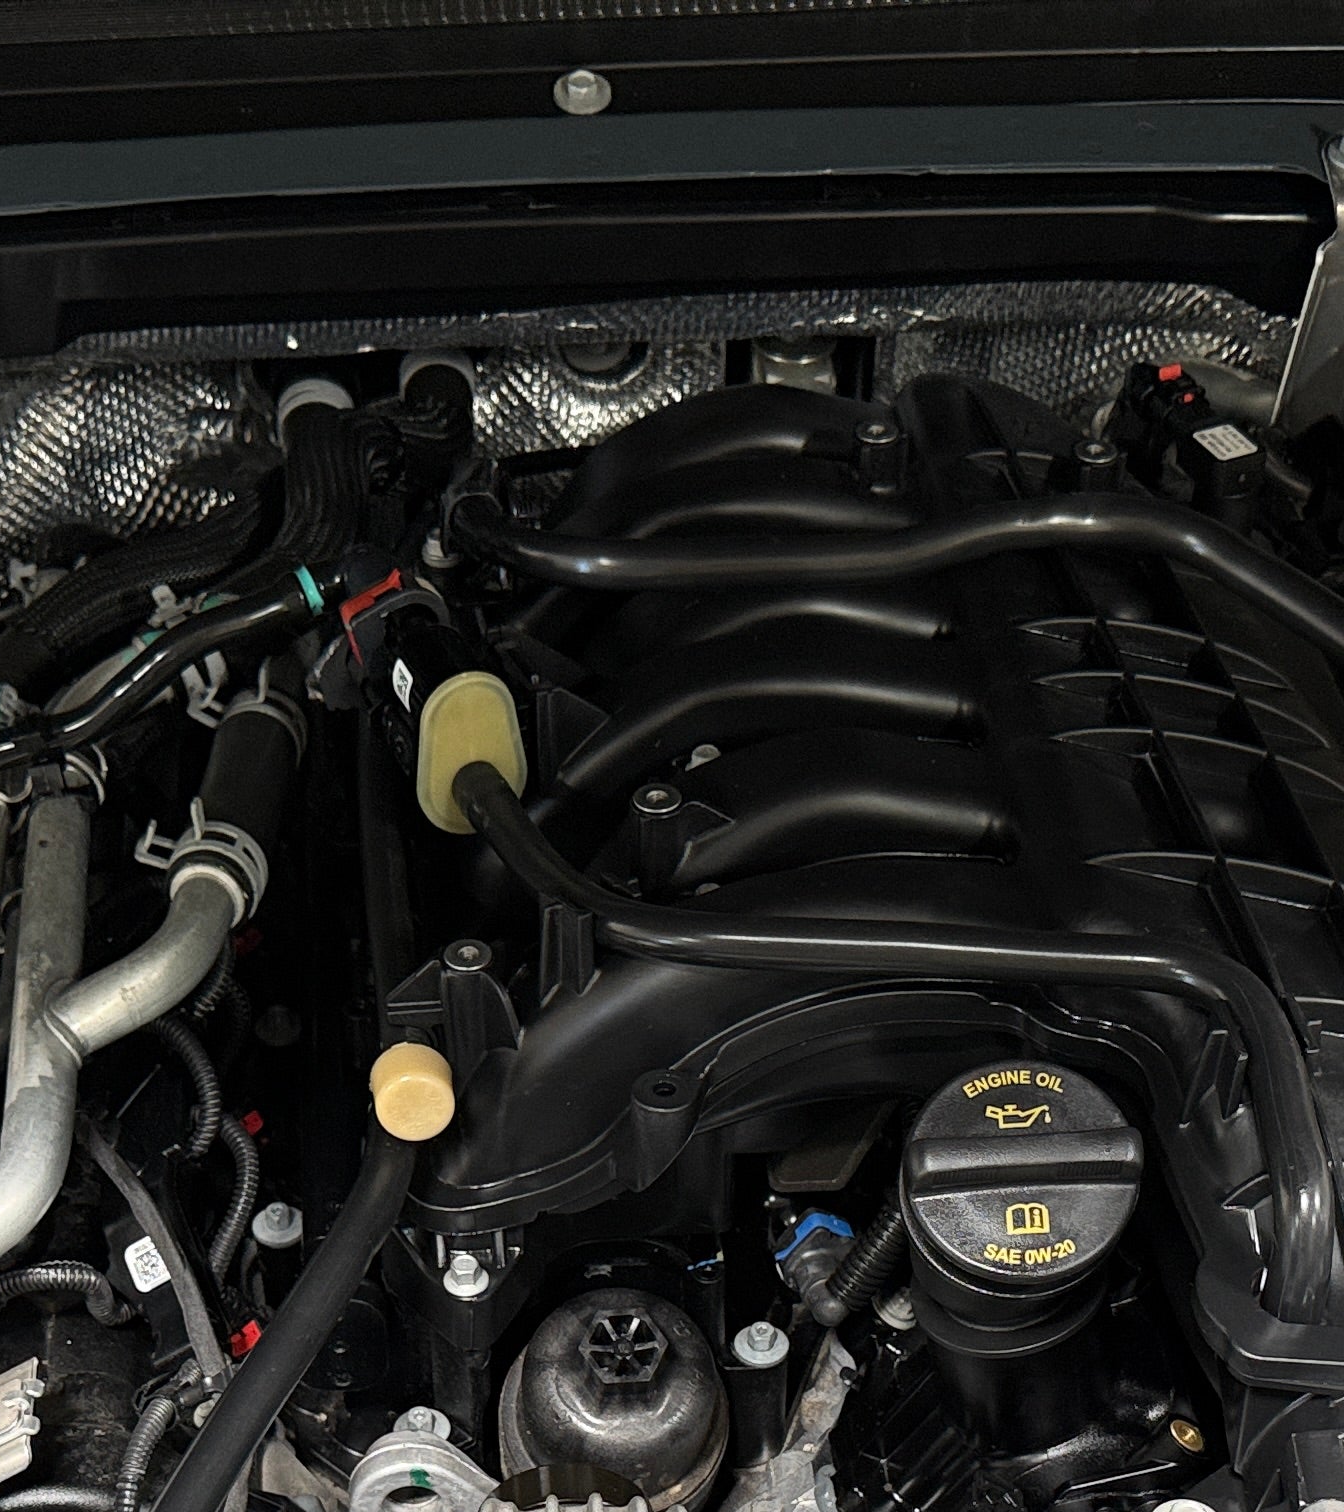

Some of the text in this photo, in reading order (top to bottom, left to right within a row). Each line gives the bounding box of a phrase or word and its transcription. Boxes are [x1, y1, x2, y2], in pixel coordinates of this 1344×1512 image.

[962, 1070, 1064, 1099] ENGINE OIL
[984, 1238, 1076, 1265] SAE 0W-20
